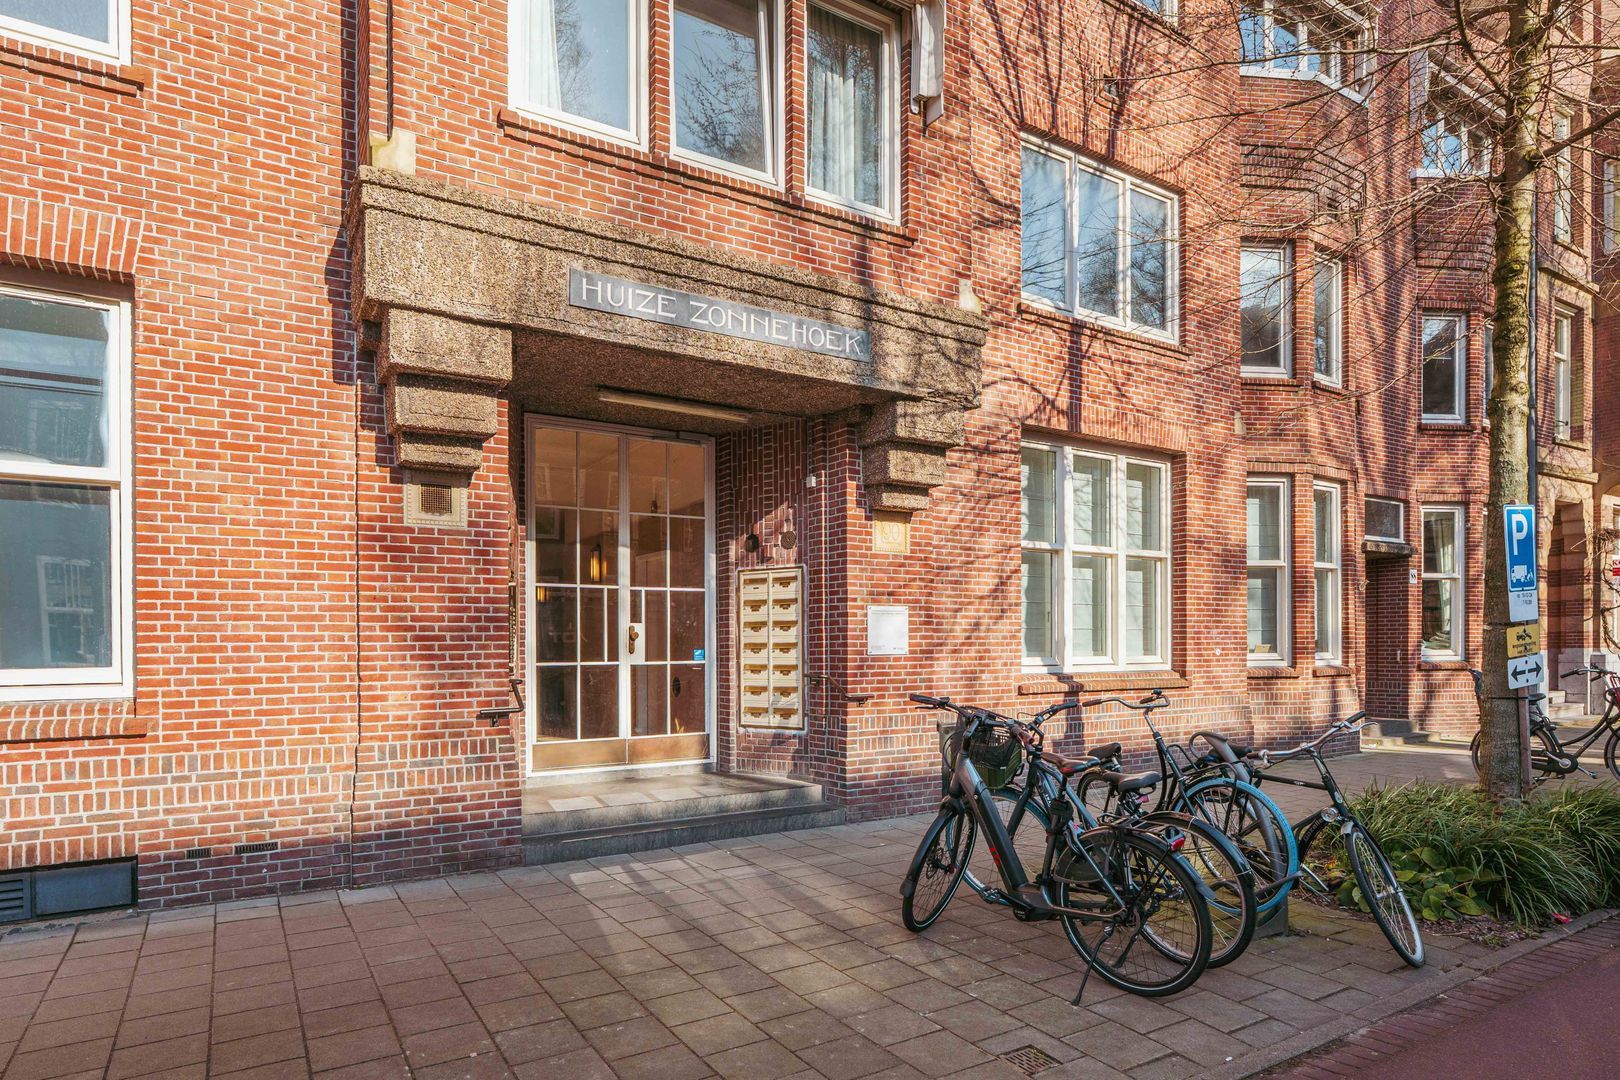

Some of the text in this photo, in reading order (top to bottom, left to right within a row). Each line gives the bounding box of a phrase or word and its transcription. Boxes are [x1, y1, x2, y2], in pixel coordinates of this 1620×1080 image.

[581, 277, 863, 355] HUIZE ZONNEHOEK
[1511, 513, 1528, 556] P
